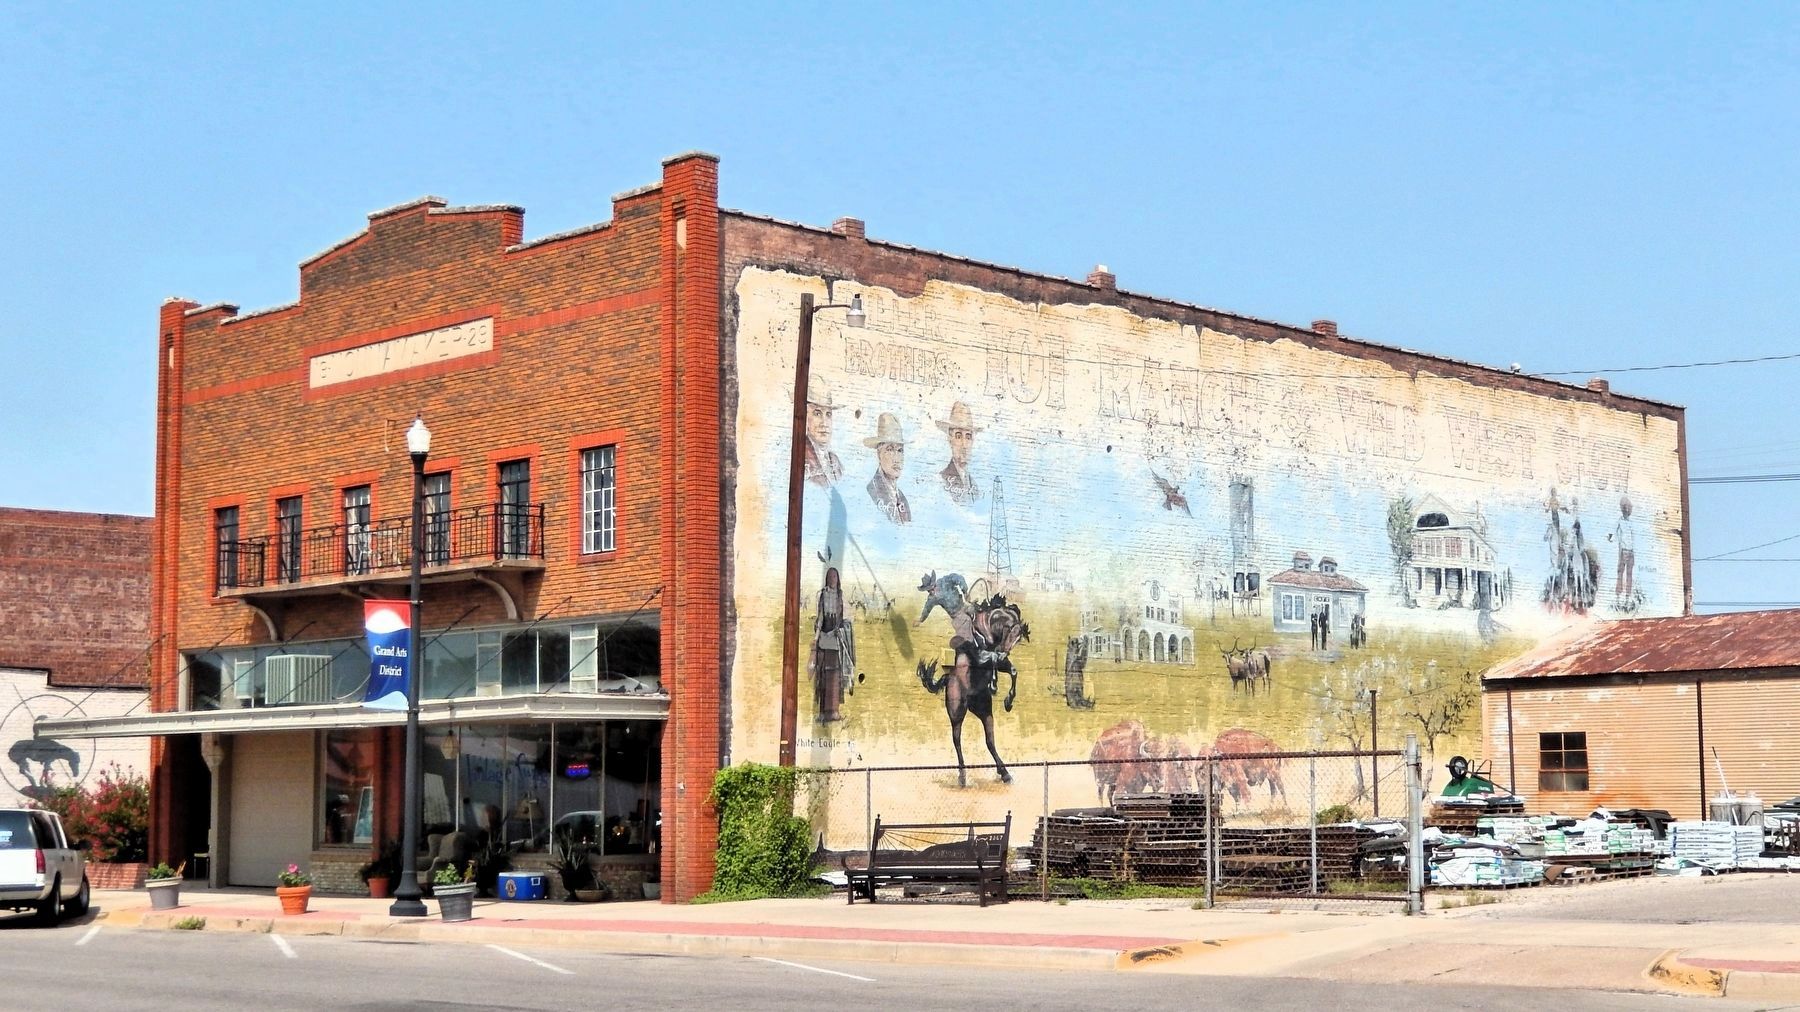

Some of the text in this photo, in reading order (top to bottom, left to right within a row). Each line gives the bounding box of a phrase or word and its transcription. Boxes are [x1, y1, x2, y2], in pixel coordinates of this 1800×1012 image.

[373, 644, 408, 658] Grand Arts
[379, 664, 403, 677] District
